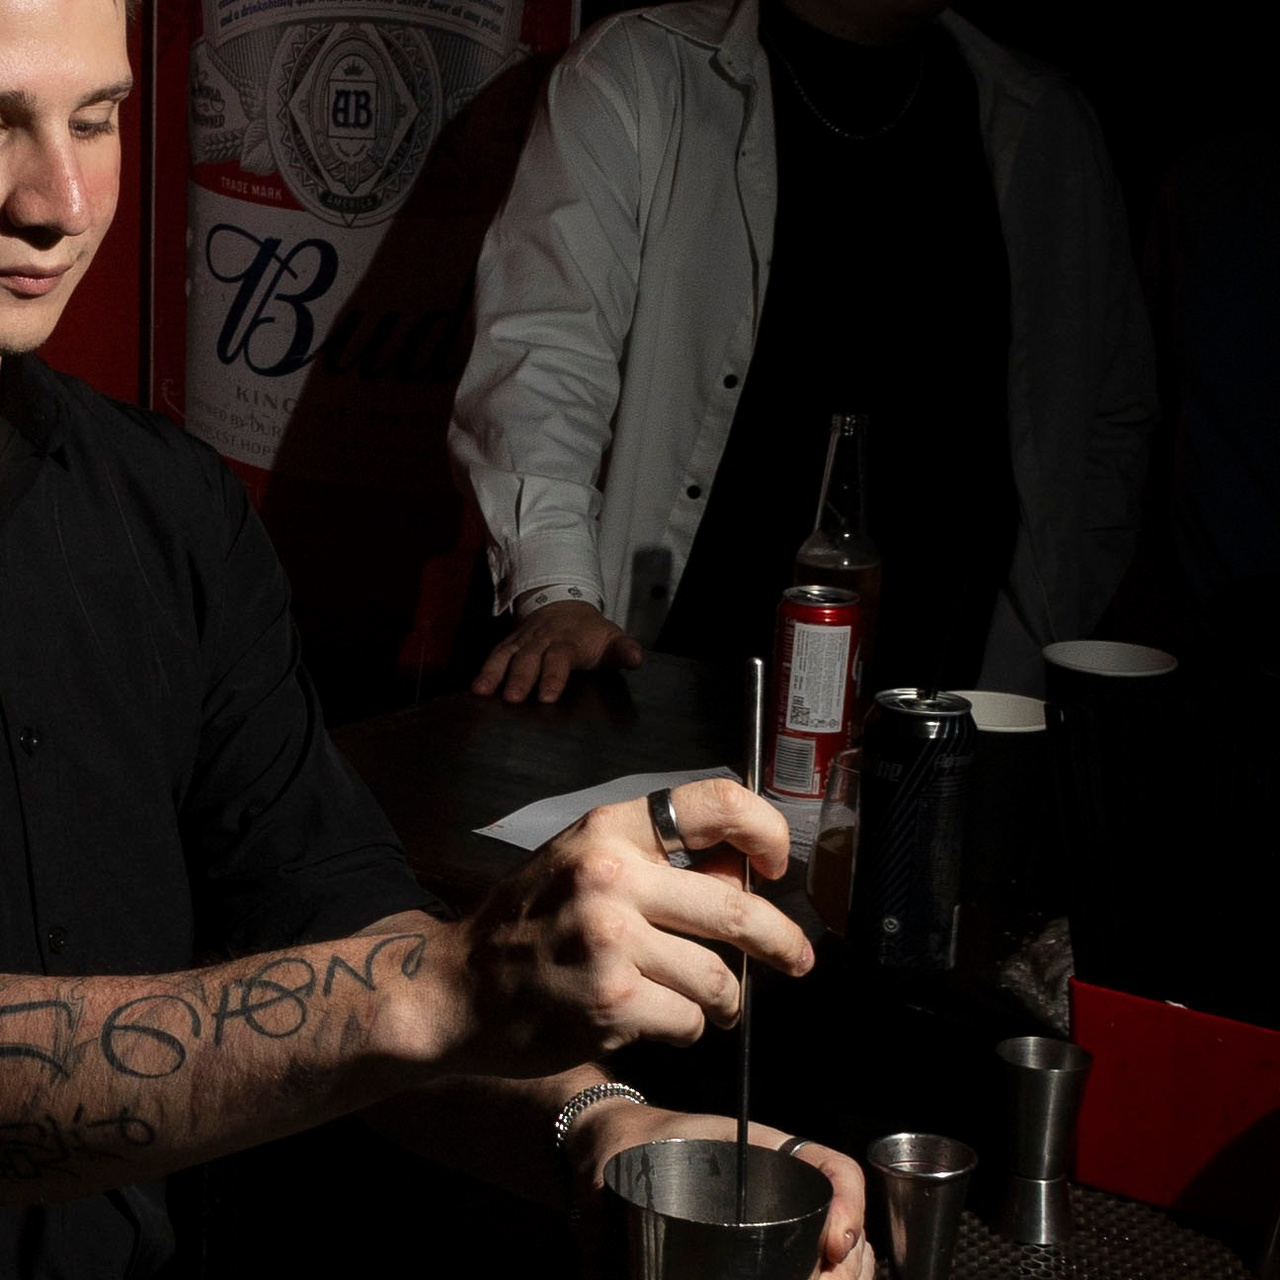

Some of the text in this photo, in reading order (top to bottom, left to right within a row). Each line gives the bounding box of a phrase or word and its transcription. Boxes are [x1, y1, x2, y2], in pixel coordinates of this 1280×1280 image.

[451, 6, 462, 17] at
[332, 88, 372, 129] AB
[221, 177, 282, 200] TRADE MARK
[206, 223, 475, 381] Bud
